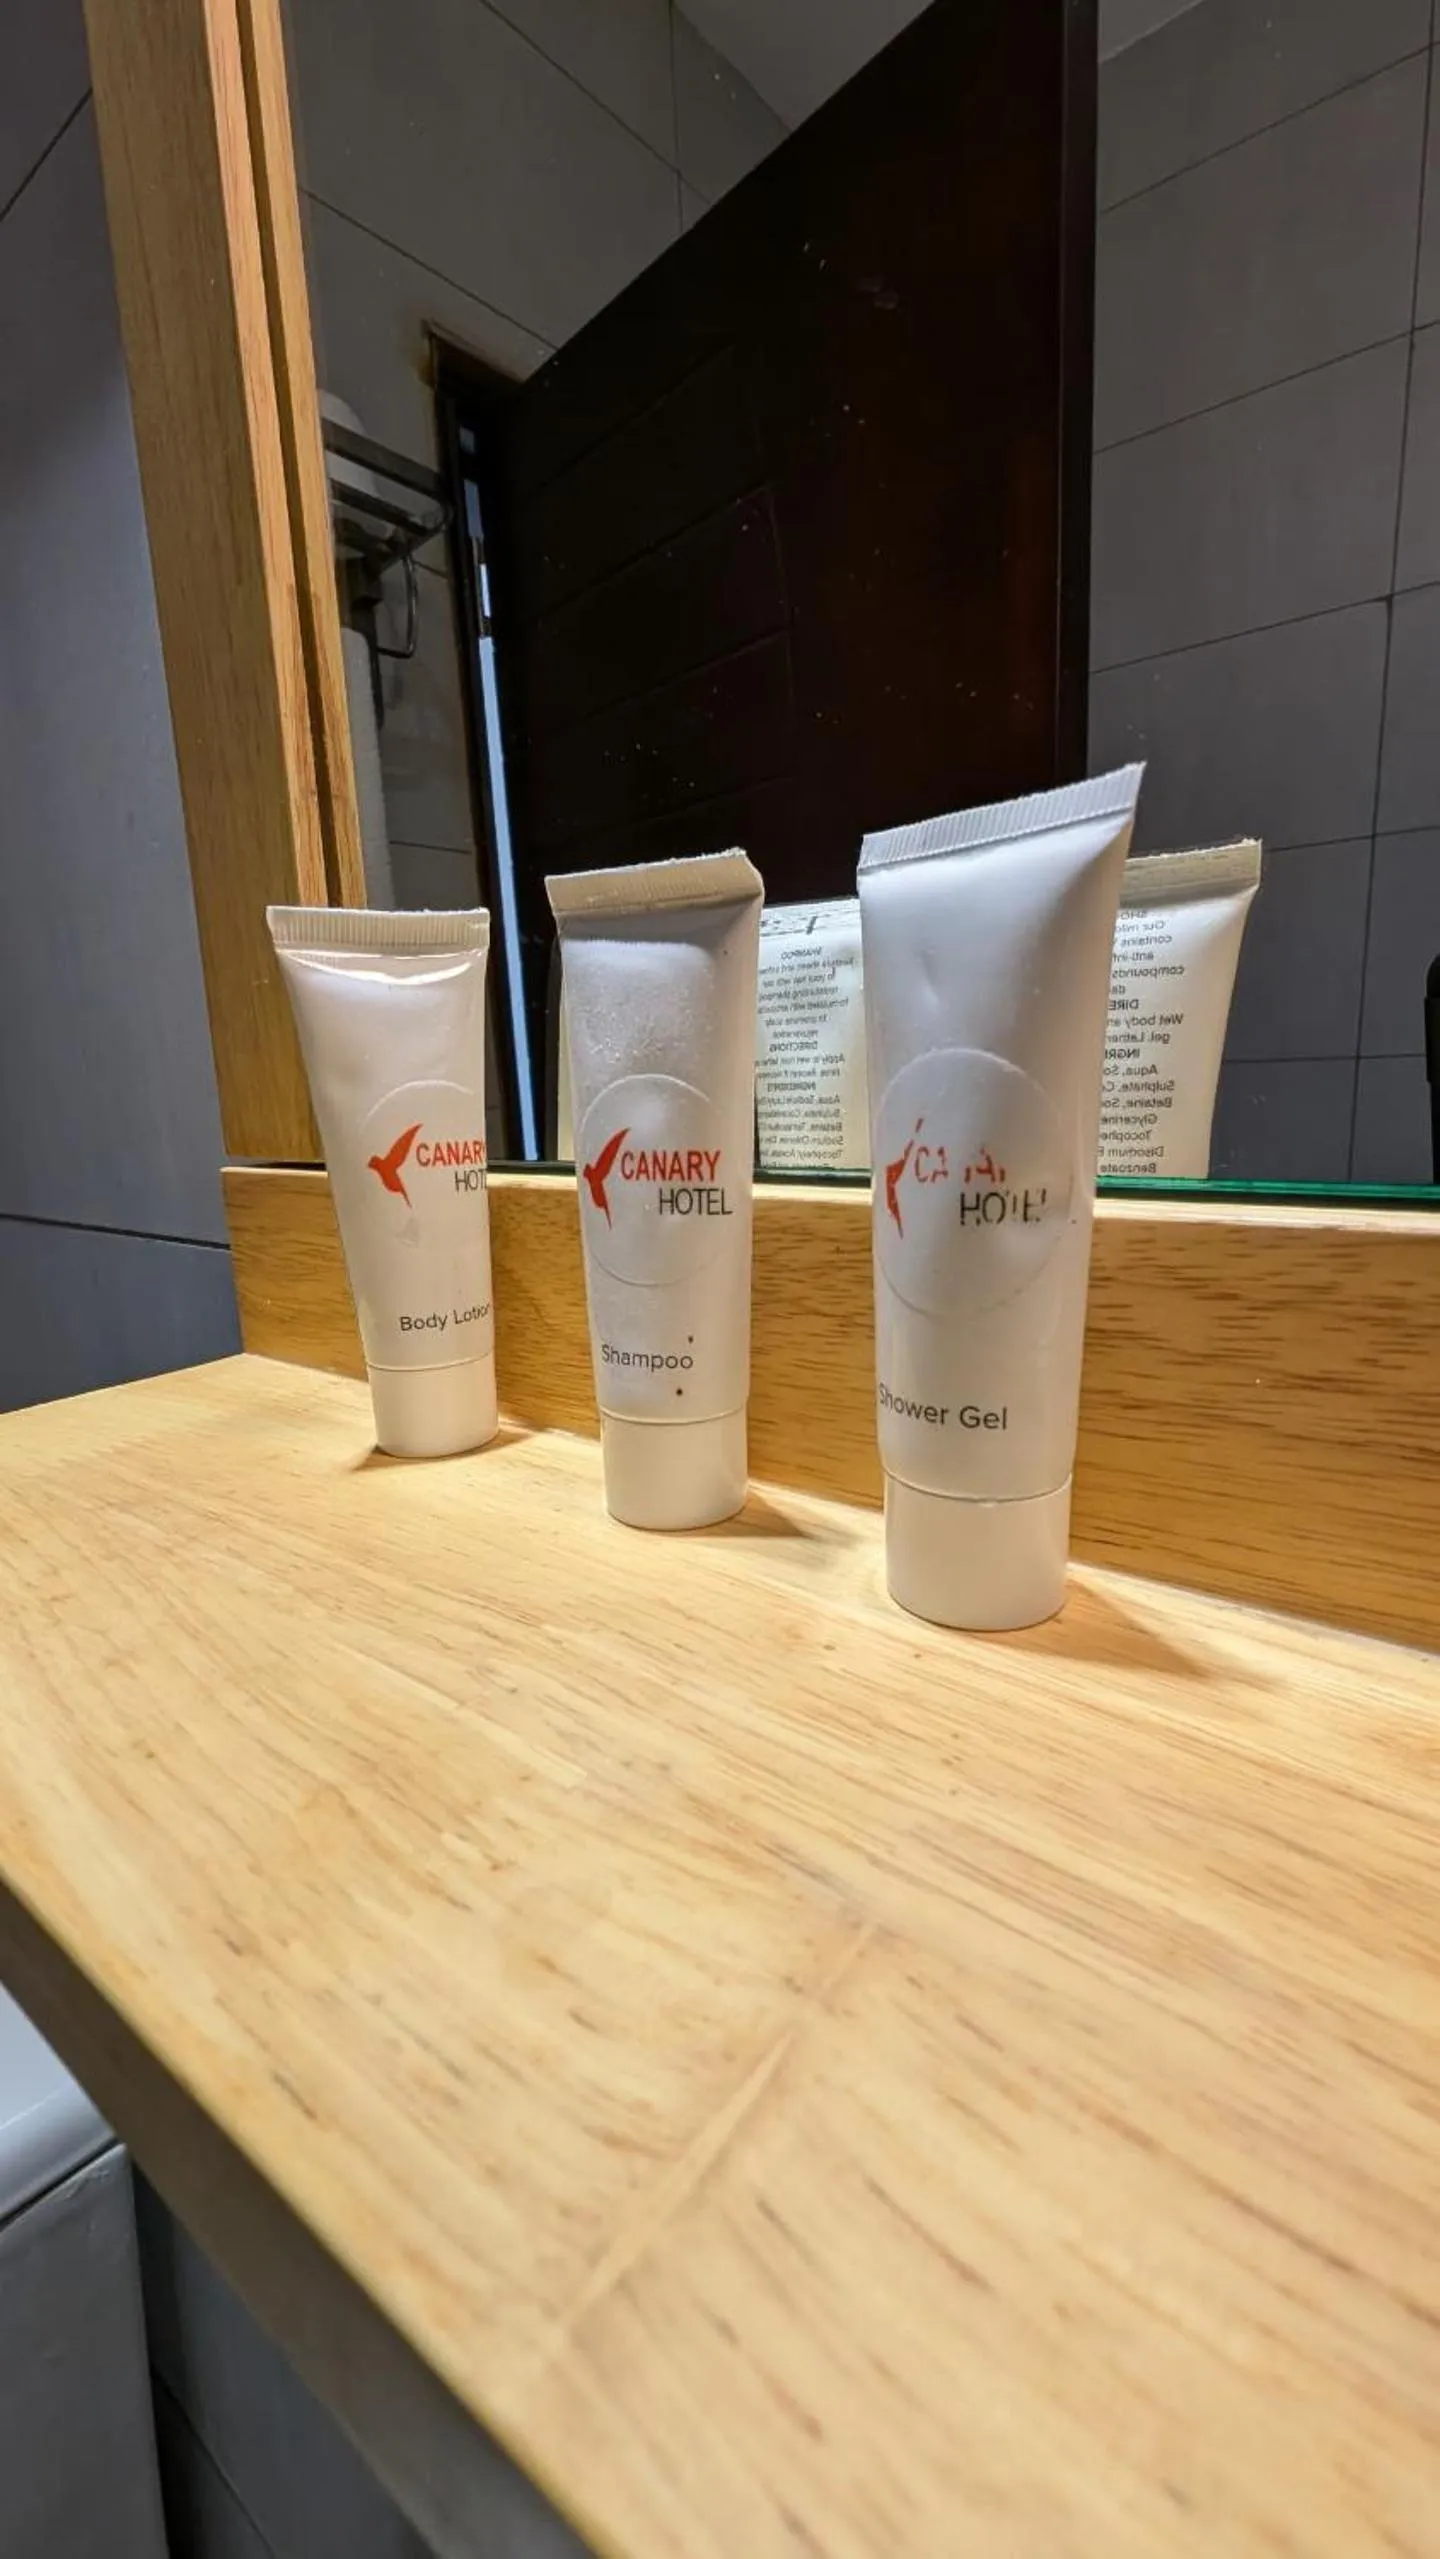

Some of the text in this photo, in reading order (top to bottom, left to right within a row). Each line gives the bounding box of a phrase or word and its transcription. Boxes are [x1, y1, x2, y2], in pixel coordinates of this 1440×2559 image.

[416, 1140, 485, 1167] CANAR
[621, 1150, 720, 1181] CANARY
[659, 1188, 733, 1215] HOTEL
[400, 1313, 447, 1331] Body
[602, 1344, 694, 1373] Shampoo
[879, 1383, 1007, 1430] Shower Gel
